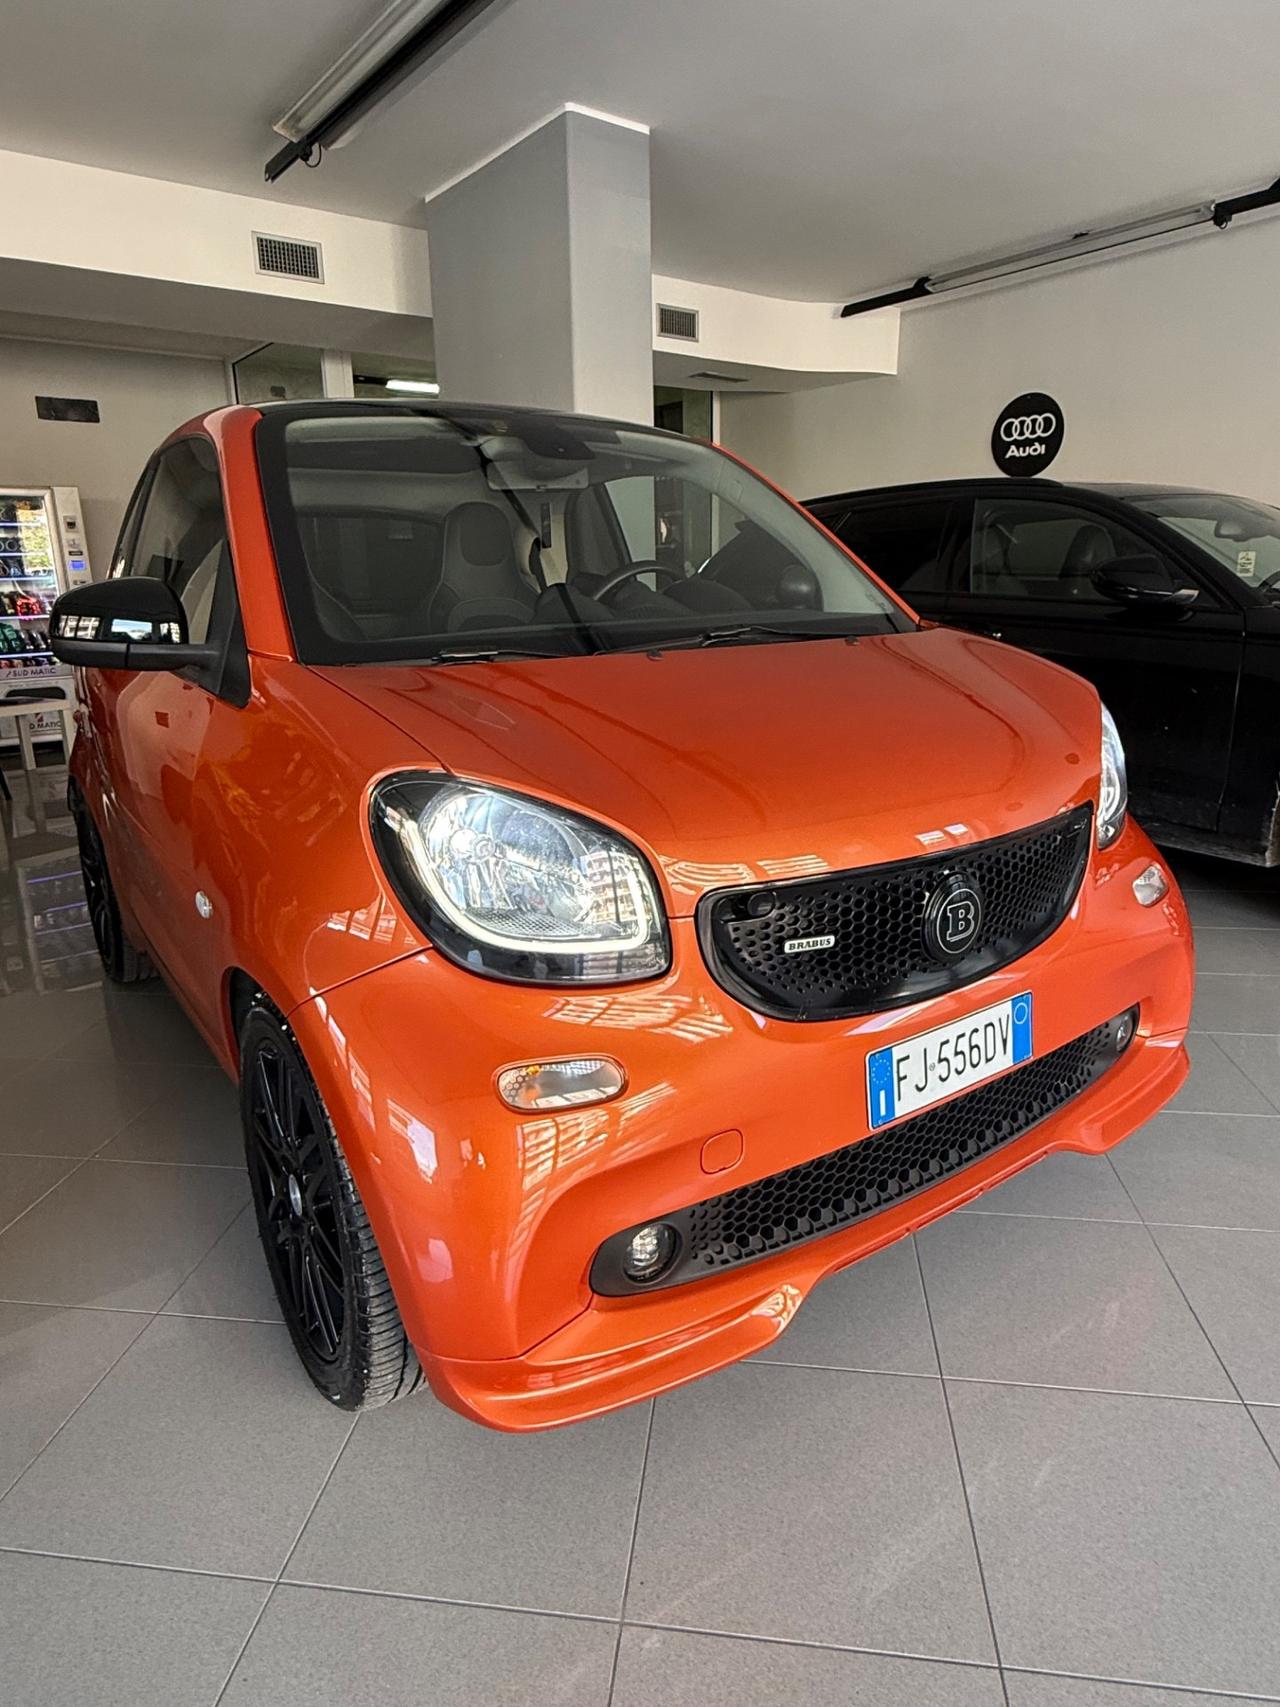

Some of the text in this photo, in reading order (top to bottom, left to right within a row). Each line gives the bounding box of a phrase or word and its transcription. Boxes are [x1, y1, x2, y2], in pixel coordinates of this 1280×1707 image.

[1004, 441, 1046, 459] Audi
[31, 667, 56, 675] MATIC
[37, 721, 61, 729] MATIC
[947, 901, 974, 942] B
[788, 938, 831, 951] BRABUS
